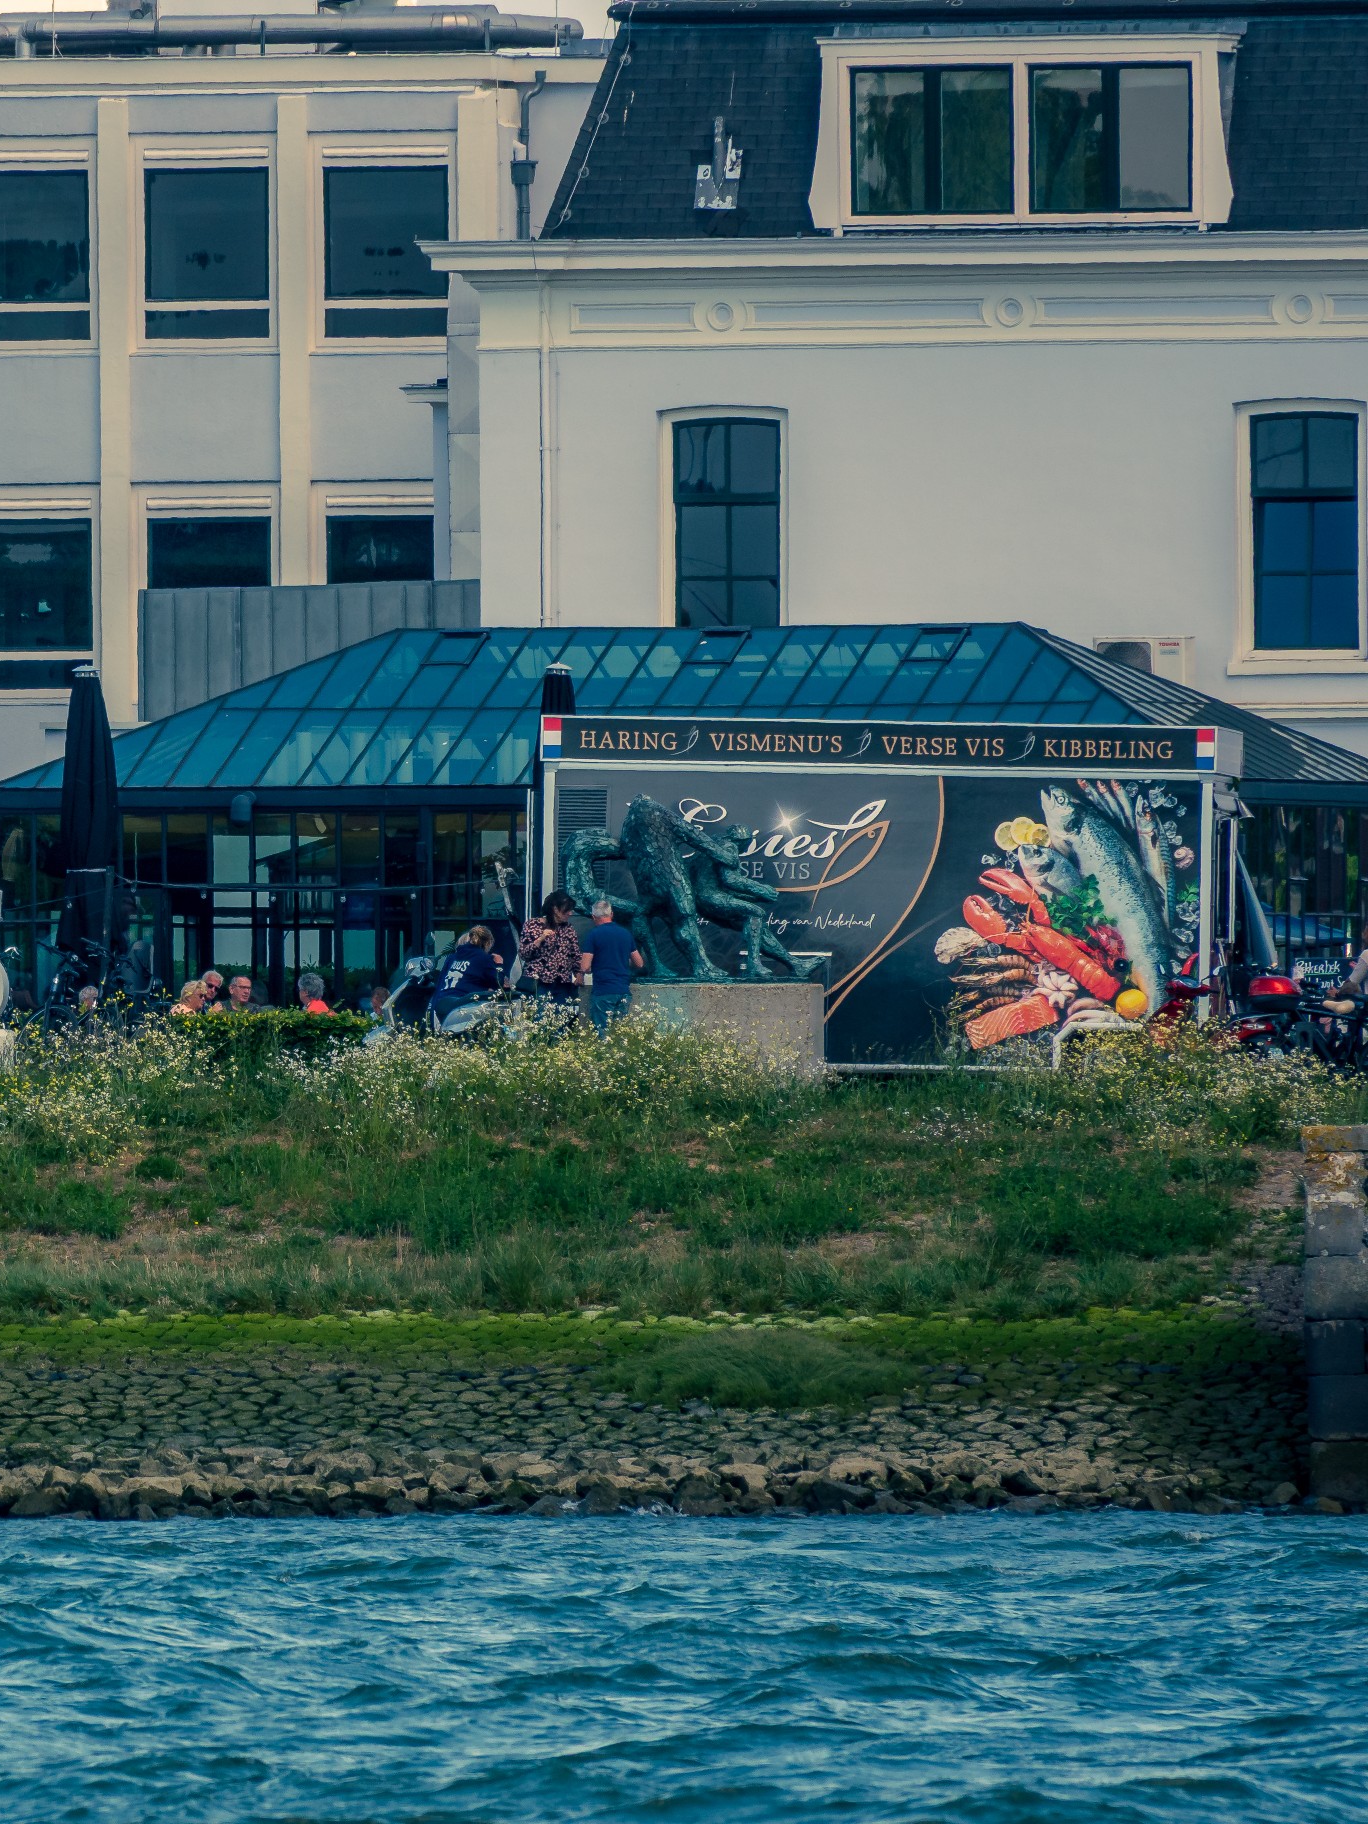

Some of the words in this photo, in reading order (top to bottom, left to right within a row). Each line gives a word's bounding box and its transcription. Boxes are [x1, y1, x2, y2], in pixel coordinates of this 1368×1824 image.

[579, 730, 677, 751] HARING
[708, 733, 843, 753] VISMENU'S
[881, 735, 957, 756] VERSE
[964, 738, 1005, 758] VIS
[1043, 739, 1174, 760] KIBBELING
[772, 861, 810, 880] VIS
[792, 917, 813, 926] van
[814, 908, 876, 930] Nederland
